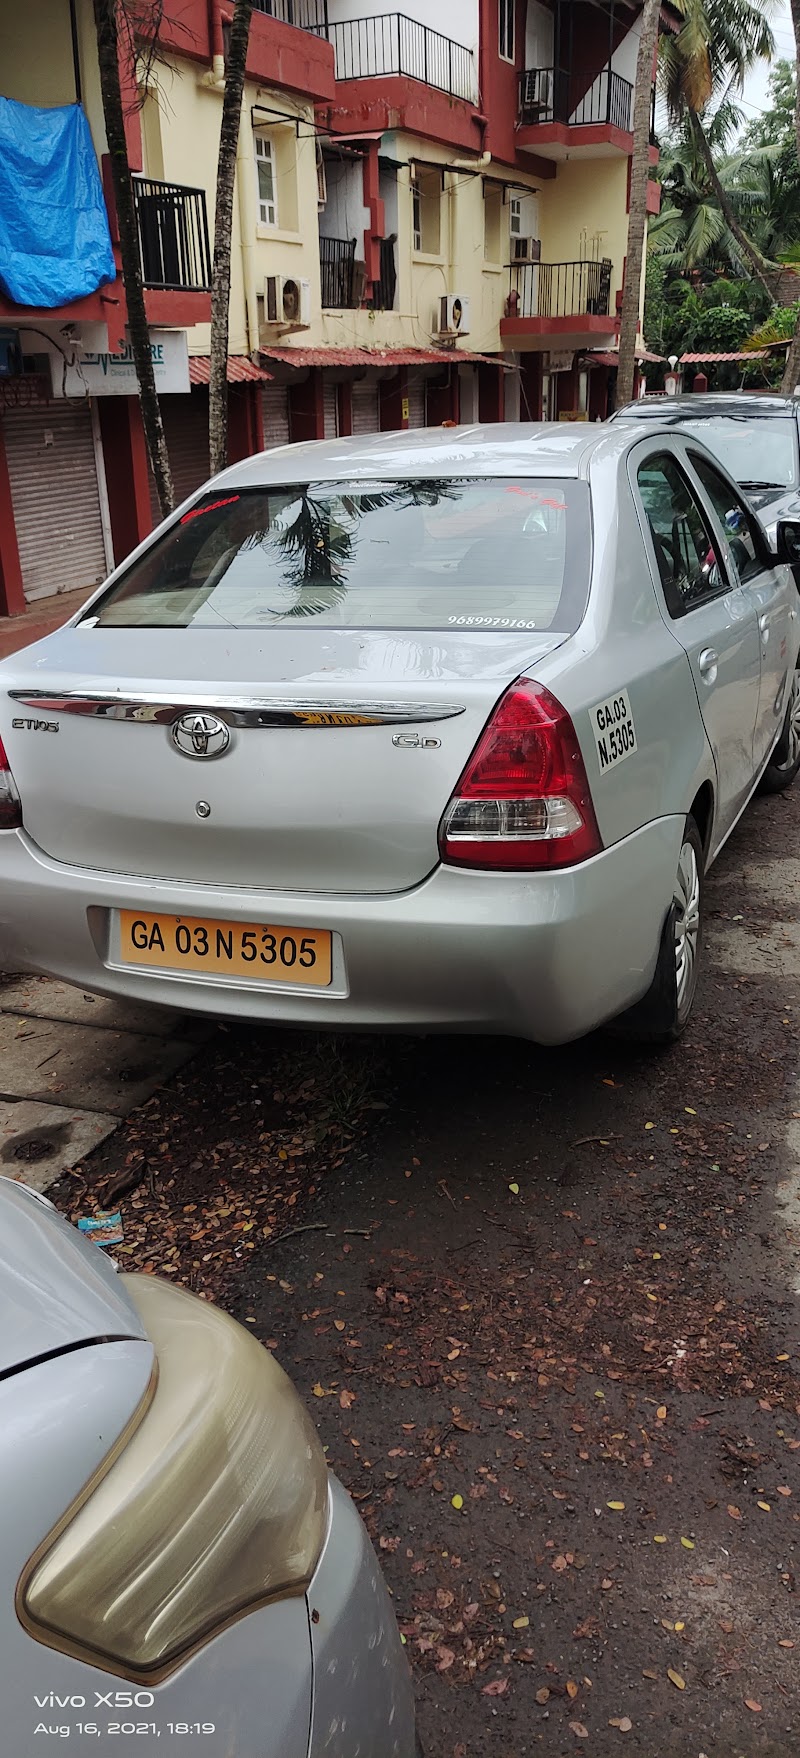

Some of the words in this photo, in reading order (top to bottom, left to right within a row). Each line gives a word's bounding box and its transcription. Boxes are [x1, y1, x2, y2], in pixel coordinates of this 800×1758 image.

[448, 615, 536, 629] 9689979166
[12, 718, 60, 733] ETIOS
[596, 696, 627, 731] GA.03
[597, 719, 635, 768] N.5305
[130, 920, 165, 952] GA
[175, 924, 209, 957] 03
[216, 928, 233, 960] N
[240, 931, 317, 968] 5305
